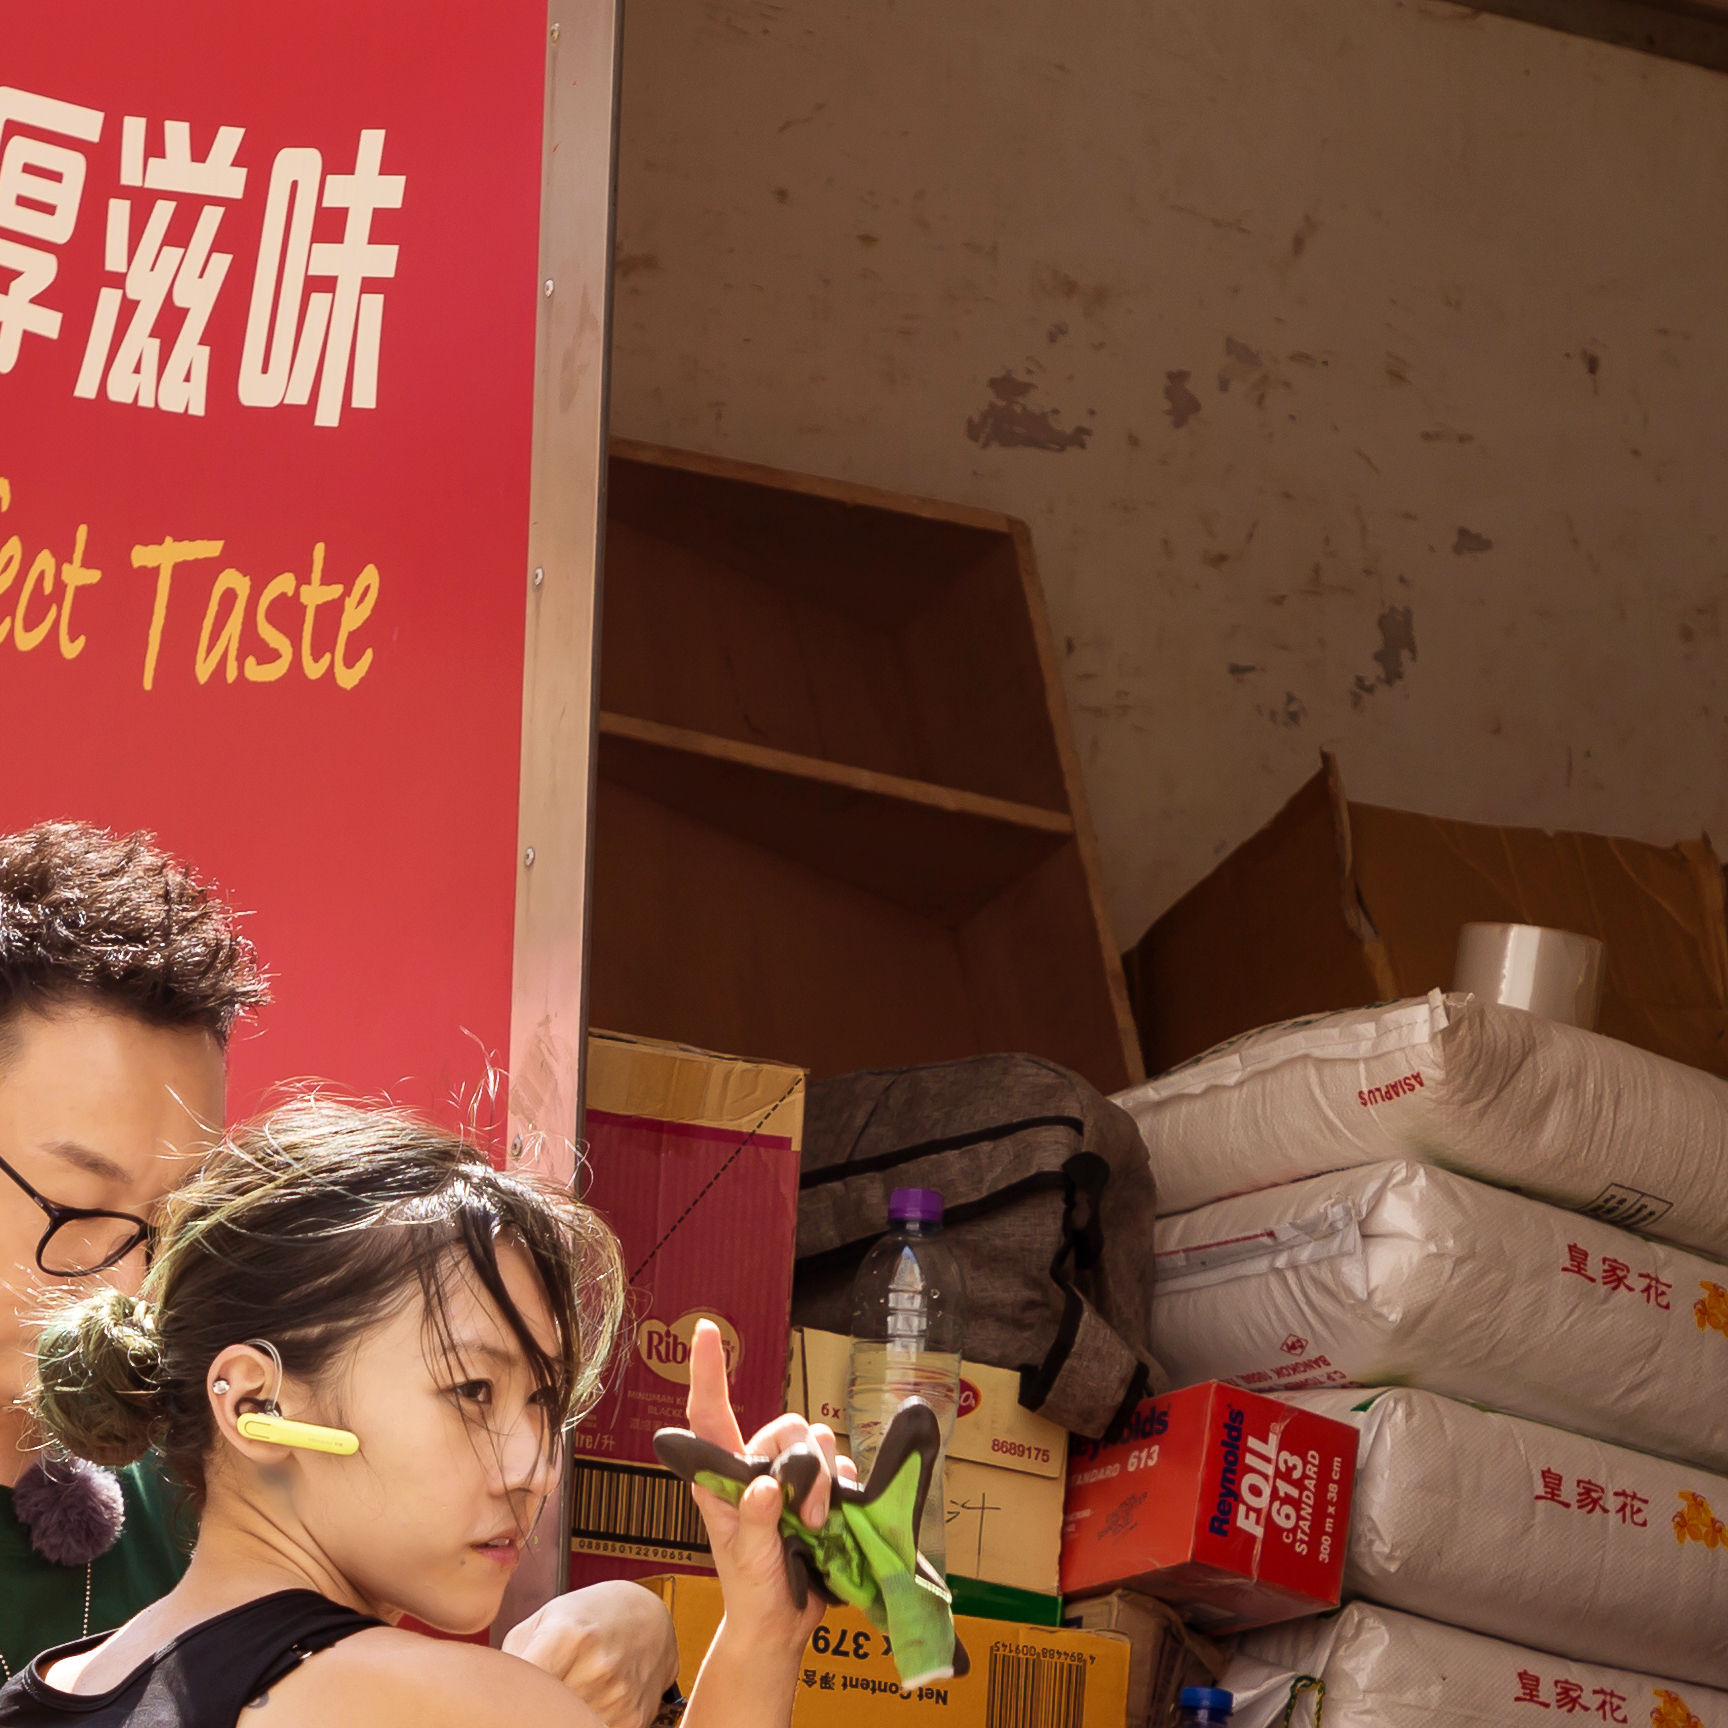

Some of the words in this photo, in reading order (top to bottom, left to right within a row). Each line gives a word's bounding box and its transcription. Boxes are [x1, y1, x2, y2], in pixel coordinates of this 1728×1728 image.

[131, 536, 381, 691] Taste
[1357, 1071, 1425, 1108] ASIAPLUS
[1561, 1242, 1672, 1310] 皇家花
[990, 1437, 1051, 1464] 8689175
[1127, 1445, 1161, 1472] 613
[1208, 1408, 1245, 1538] Reynolds
[1332, 1456, 1343, 1481] cm
[1236, 1434, 1278, 1538] FOIL
[1272, 1450, 1304, 1530] 613
[1294, 1449, 1320, 1556] STANDARD
[1330, 1483, 1339, 1502] 38
[1534, 1466, 1650, 1527] 皇家花
[1318, 1536, 1331, 1564] 300
[811, 1625, 872, 1661] 379
[917, 1686, 949, 1706] Net
[1514, 1669, 1628, 1725] 皇家花
